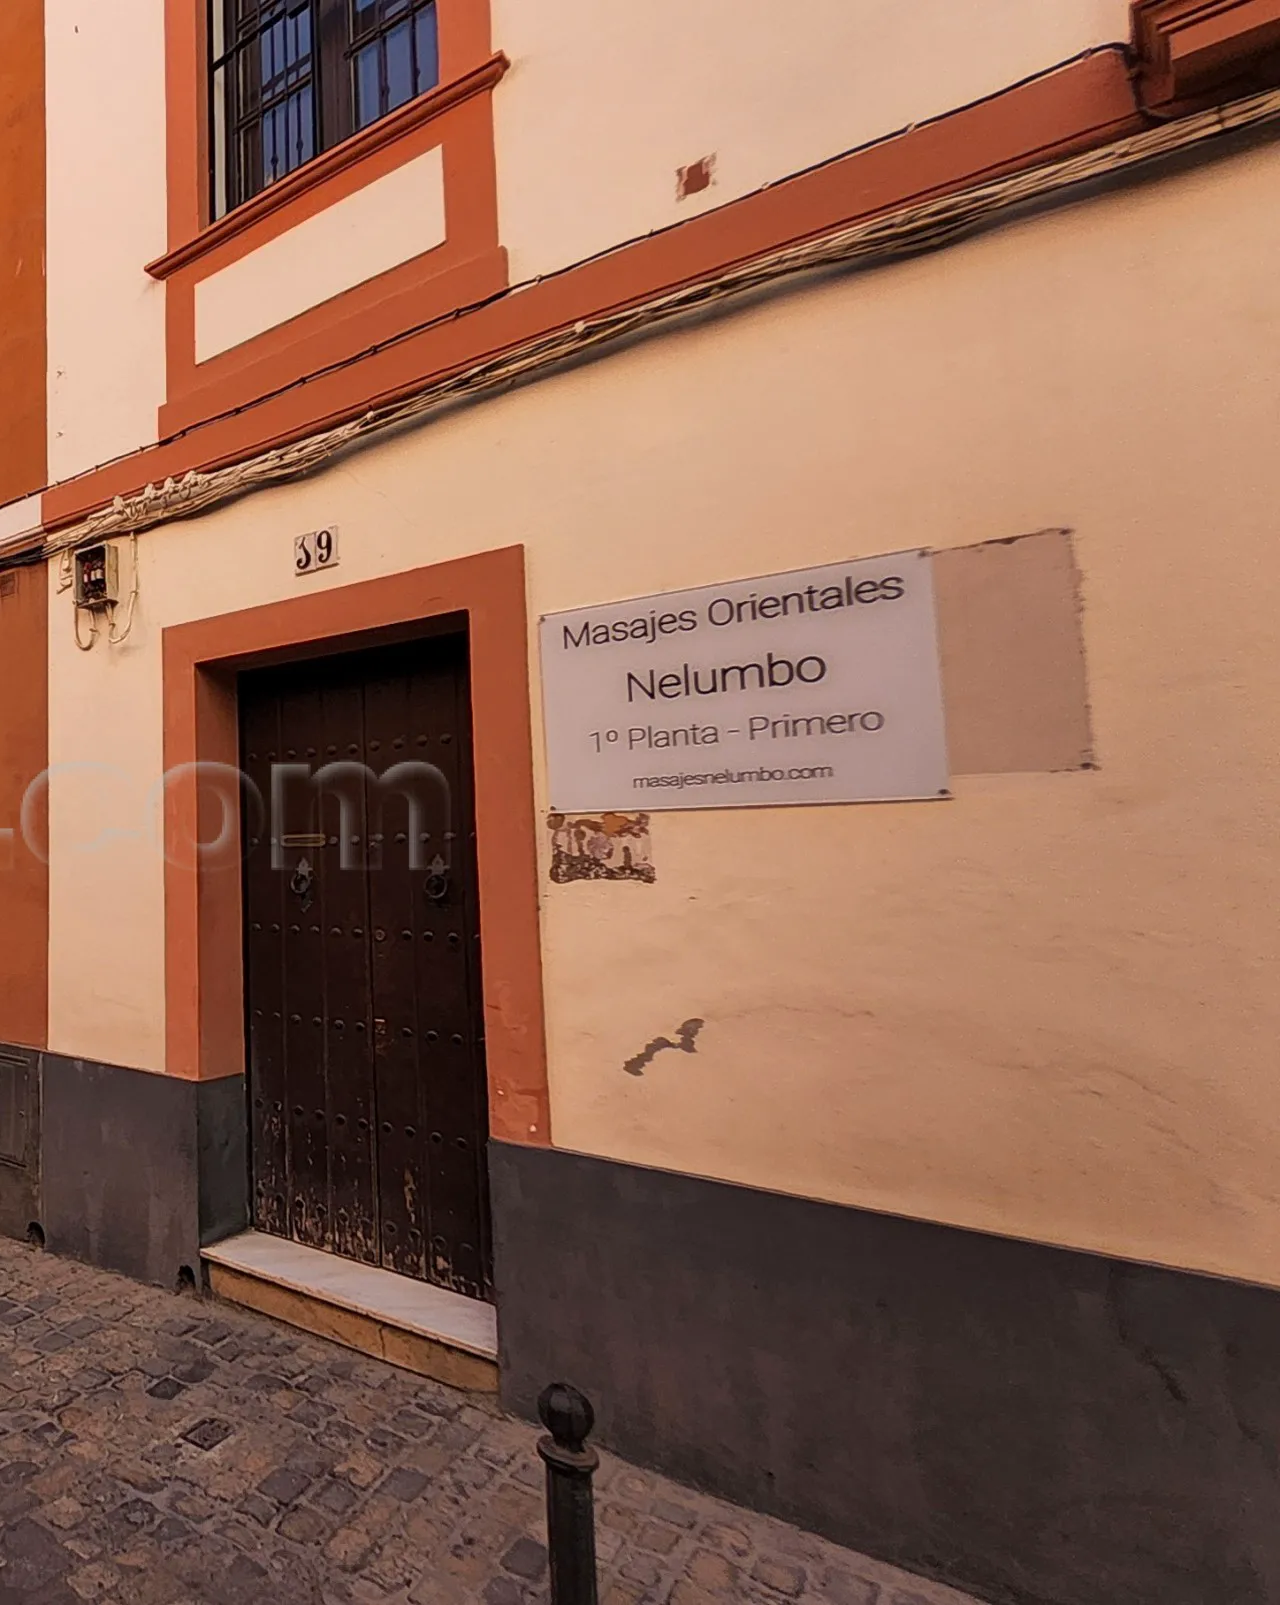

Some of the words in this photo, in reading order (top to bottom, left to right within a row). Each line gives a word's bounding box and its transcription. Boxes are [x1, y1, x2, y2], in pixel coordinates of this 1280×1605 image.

[562, 610, 698, 650] Masajes
[707, 575, 905, 627] Orientales
[626, 652, 827, 703] Nelumbo
[589, 729, 619, 754] 1º
[628, 724, 720, 751] Planta
[748, 711, 886, 741] Primero
[632, 766, 835, 790] masajesnelumbo.com
